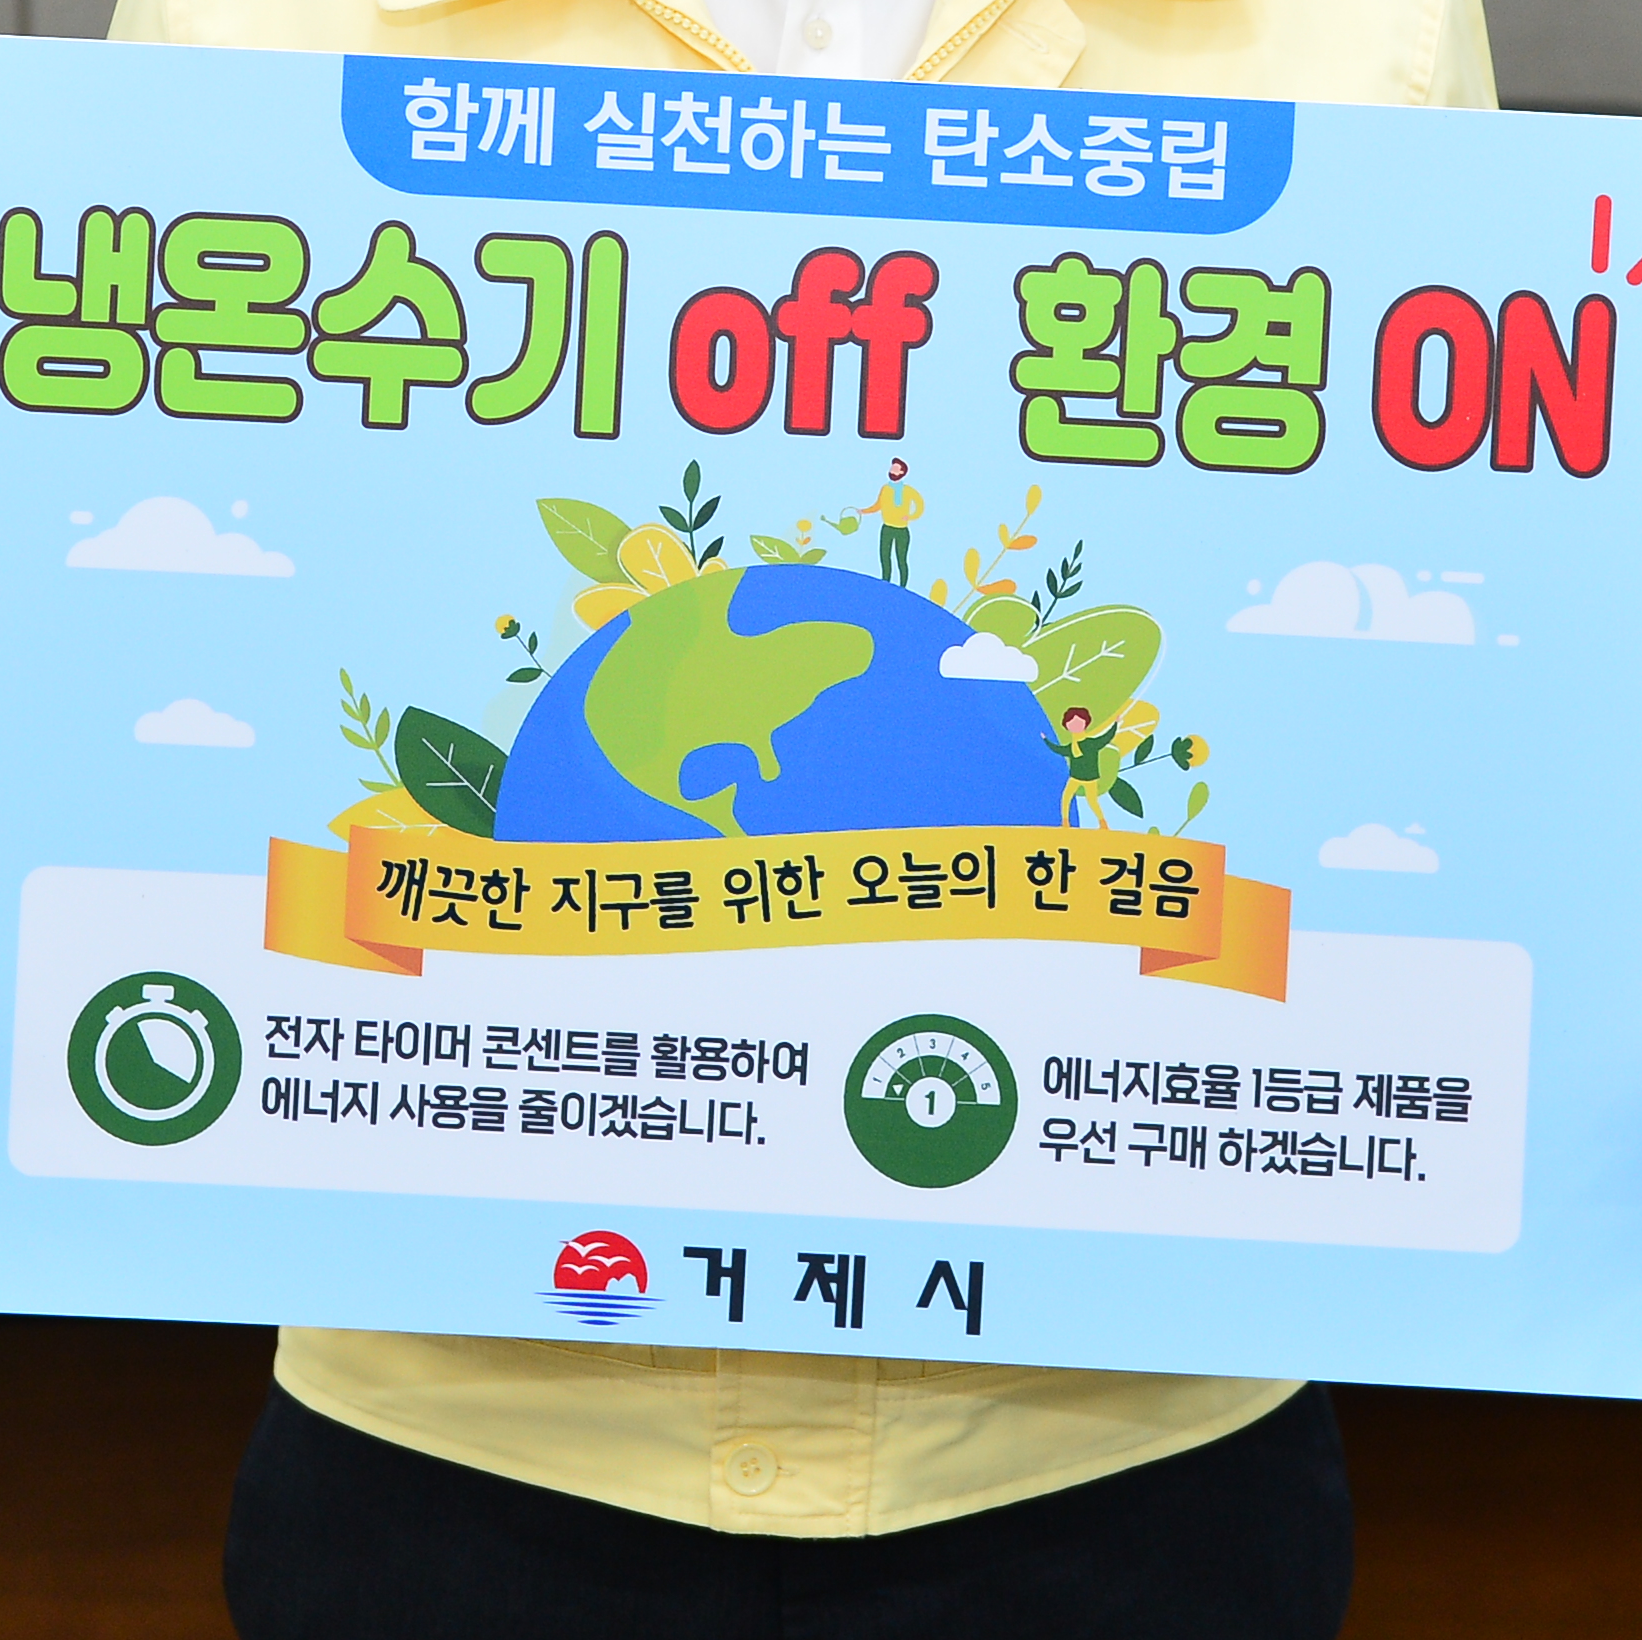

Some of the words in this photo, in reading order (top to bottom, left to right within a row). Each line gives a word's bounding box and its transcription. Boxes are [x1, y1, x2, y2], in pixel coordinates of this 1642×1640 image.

[404, 77, 555, 166] 함께
[584, 91, 892, 182] 실천하는
[924, 108, 1228, 200] 탄소중립
[669, 246, 939, 439] off
[1009, 252, 1332, 475] 환경
[1372, 284, 1616, 479] ON
[376, 857, 531, 931] 깨끗한
[551, 869, 700, 933] 지구를
[723, 855, 825, 924] 위한
[846, 844, 996, 910] 오늘의
[1024, 848, 1077, 912] 한
[1099, 852, 1200, 919] 걸음
[265, 1015, 345, 1062] 전자
[354, 1020, 471, 1068] 타이머
[482, 1025, 641, 1077] 콘센트를
[650, 1033, 809, 1086] 활용하여
[261, 1077, 379, 1126] 에너지
[389, 1083, 509, 1132] 사용을
[518, 1089, 766, 1145] 줄이겠습니다.
[924, 1090, 937, 1116] 1
[1043, 1056, 1241, 1110] 에너지효율
[1252, 1067, 1344, 1115] 1등급
[1352, 1074, 1472, 1123] 제품을
[1039, 1118, 1117, 1165] 우선
[1128, 1122, 1207, 1170] 구매
[1218, 1127, 1426, 1182] 하겠습니다.
